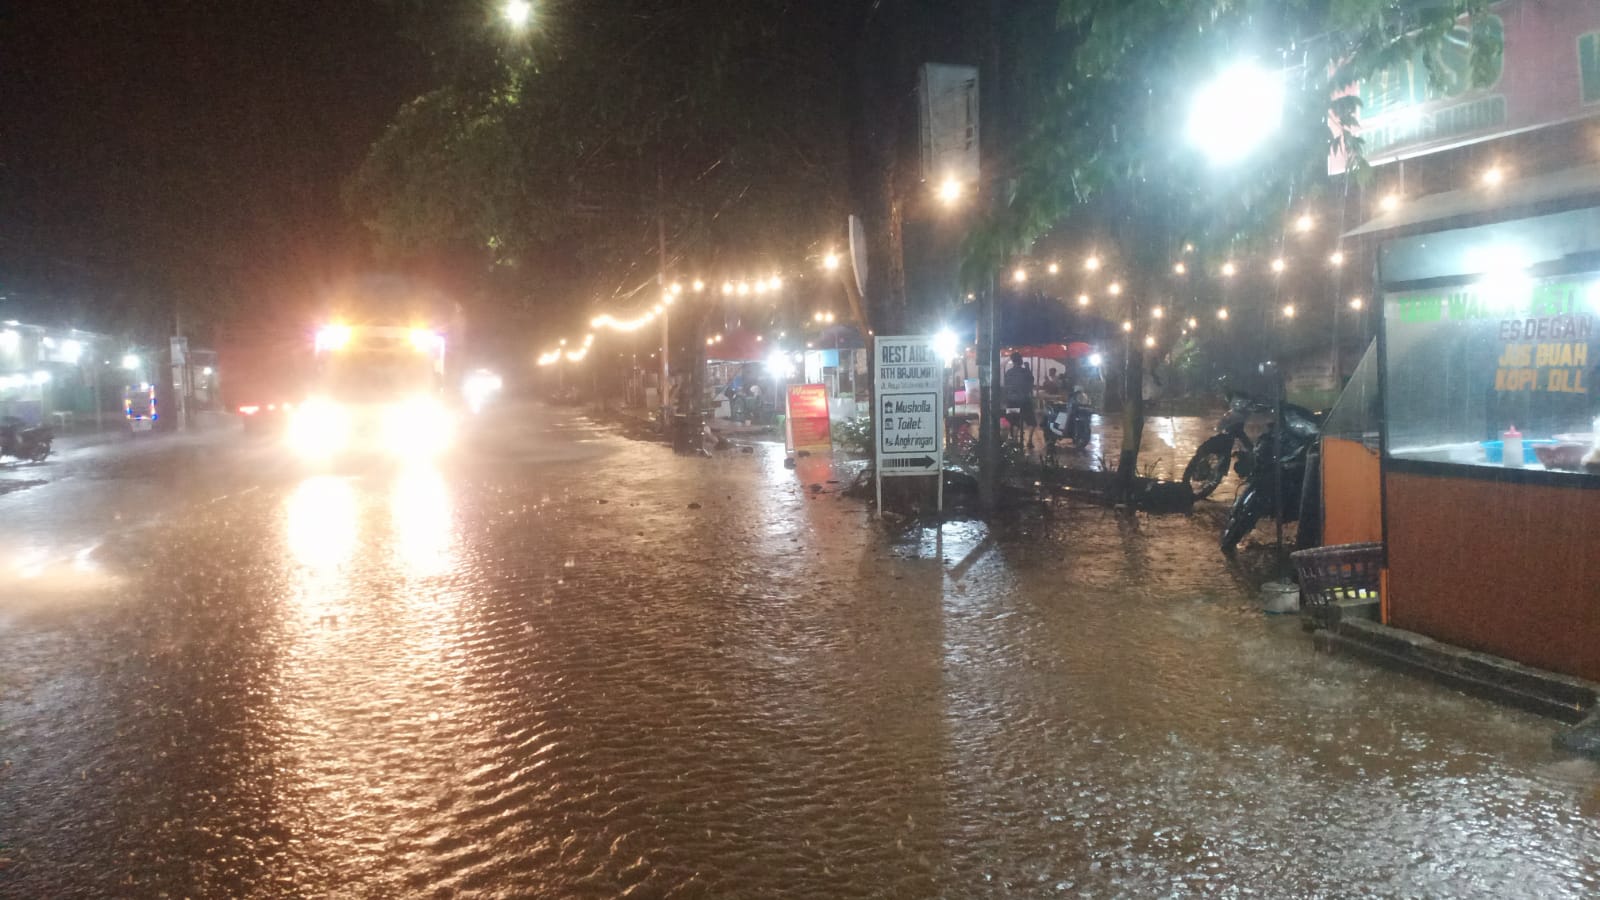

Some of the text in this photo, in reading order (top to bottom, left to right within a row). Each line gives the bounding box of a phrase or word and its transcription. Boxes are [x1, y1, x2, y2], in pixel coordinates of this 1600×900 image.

[1500, 317, 1592, 339] ES DEGAN
[882, 345, 906, 363] REST
[1500, 343, 1587, 366] JUS BUAH
[1547, 368, 1587, 393] DLL
[895, 400, 931, 413] Musholla
[897, 416, 922, 430] Toilet
[895, 435, 933, 449] Angkringan
